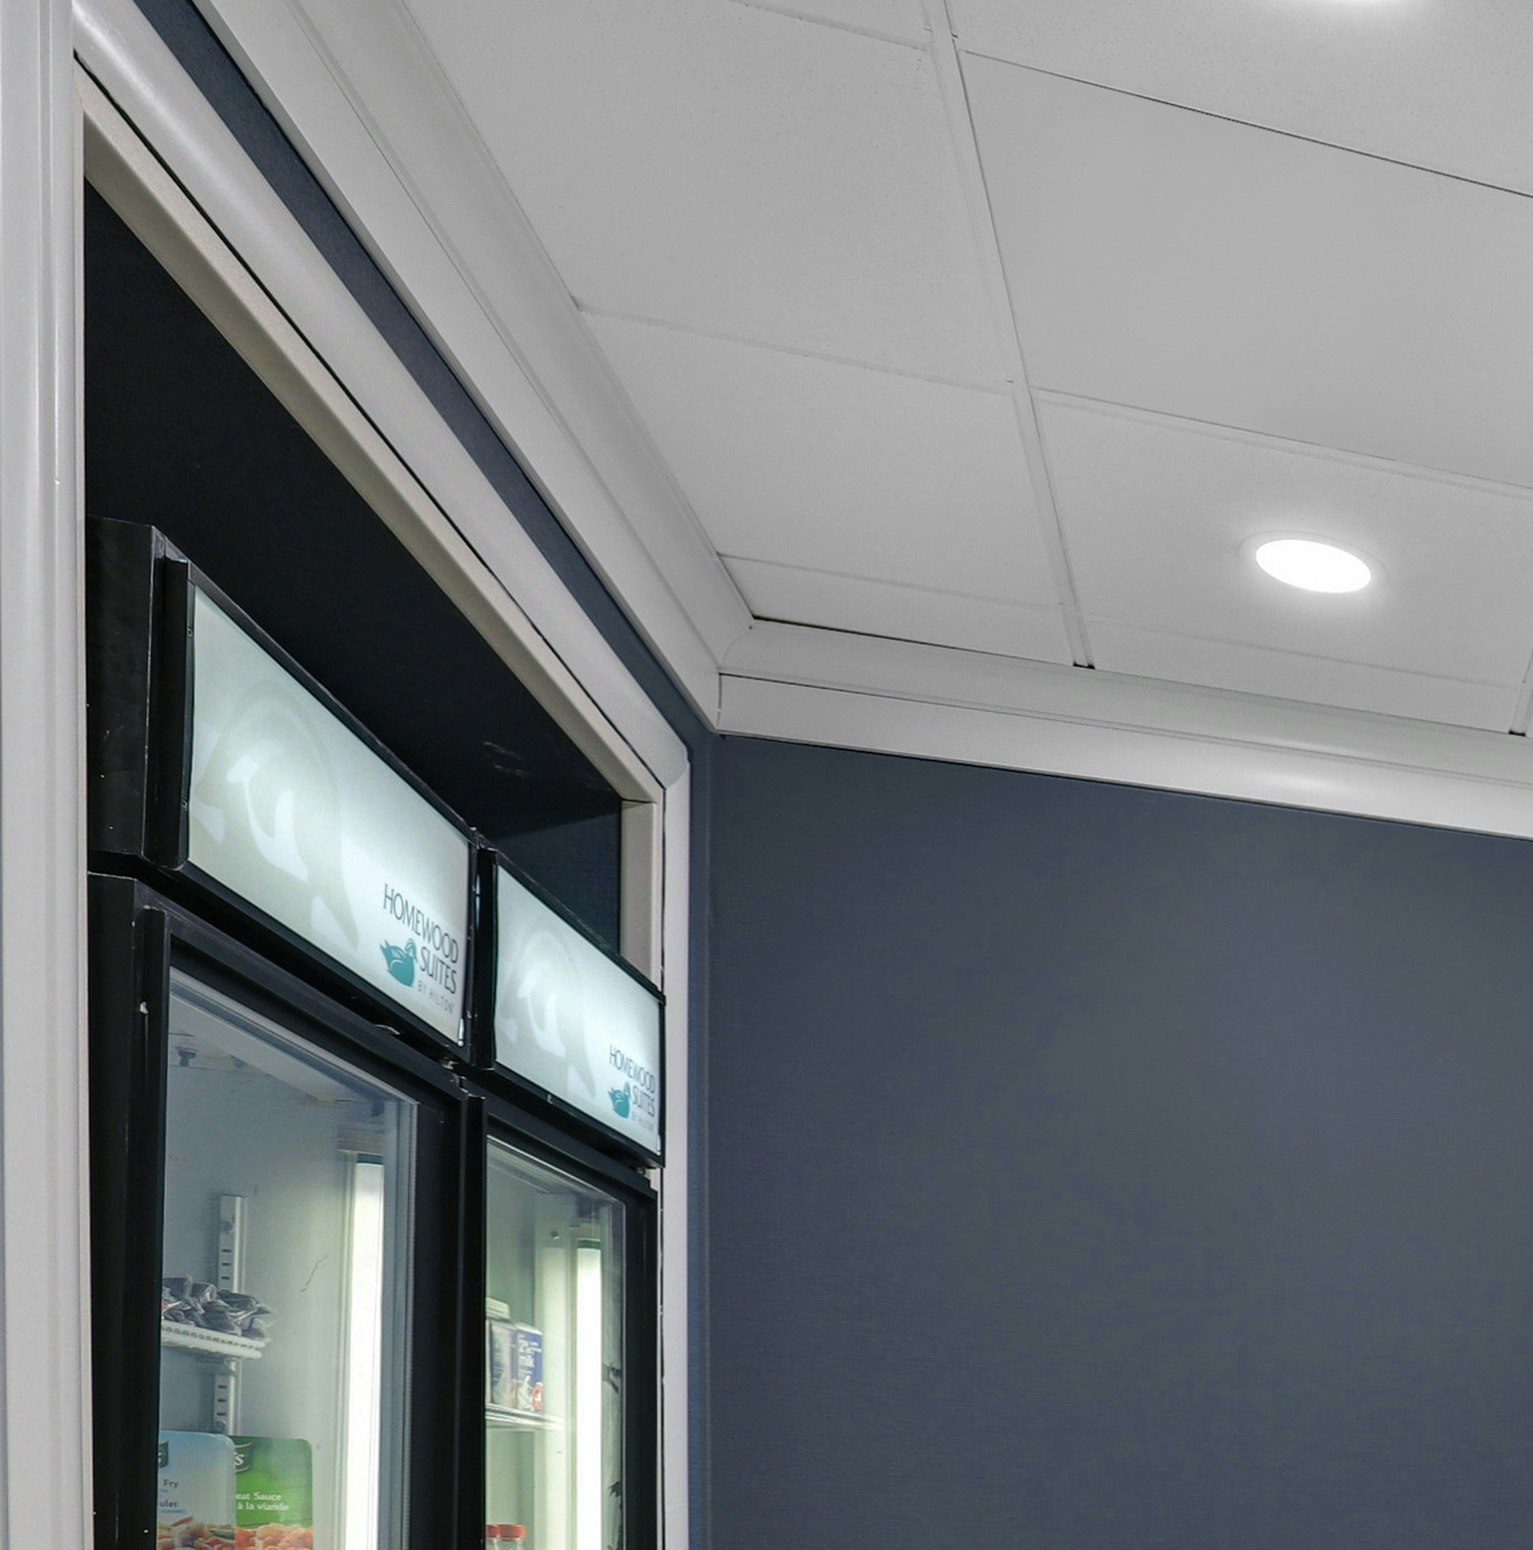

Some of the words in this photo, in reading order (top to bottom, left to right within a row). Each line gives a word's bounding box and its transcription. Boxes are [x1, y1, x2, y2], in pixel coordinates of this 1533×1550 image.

[383, 883, 459, 965] HOMEWOOD
[420, 946, 457, 995] SUITES
[417, 980, 427, 993] BY
[610, 1045, 656, 1093] HOMEWOOD
[632, 1083, 656, 1118] SUITES
[163, 1478, 179, 1490] Fry
[254, 1491, 282, 1501] Sauce
[246, 1502, 255, 1511] la
[256, 1502, 290, 1512] viande
